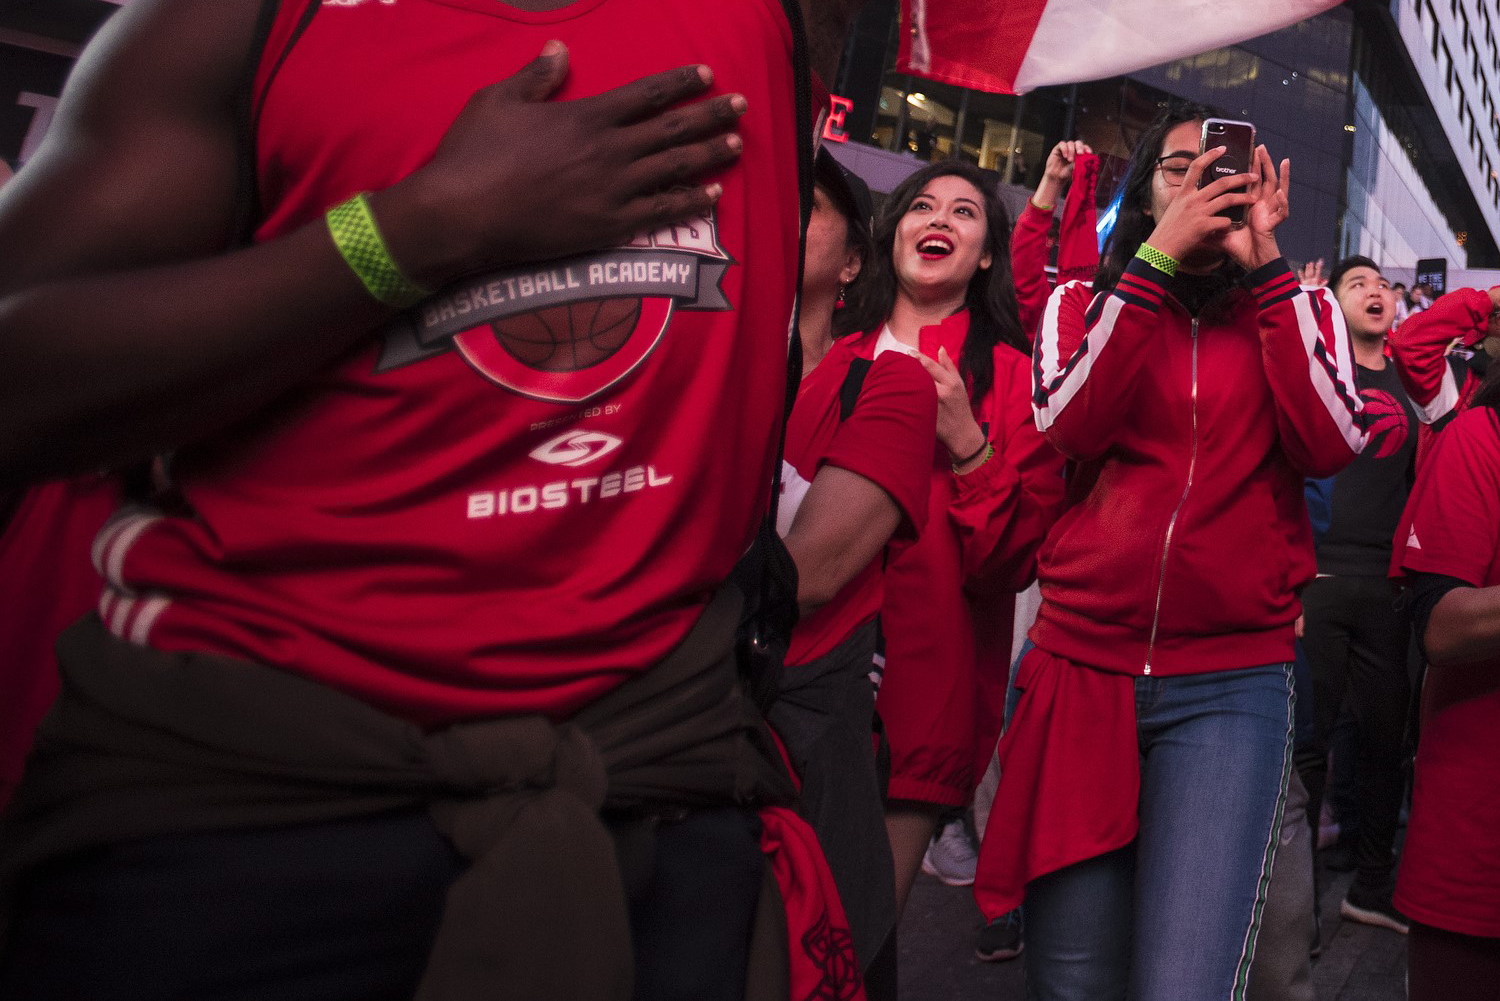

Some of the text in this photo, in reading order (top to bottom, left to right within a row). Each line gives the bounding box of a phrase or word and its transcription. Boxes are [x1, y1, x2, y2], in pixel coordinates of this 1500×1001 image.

[1215, 166, 1237, 174] brother
[424, 261, 690, 329] BASKETBALL ACADEMY
[604, 403, 622, 416] BY
[466, 465, 674, 519] BIOSTEEL
